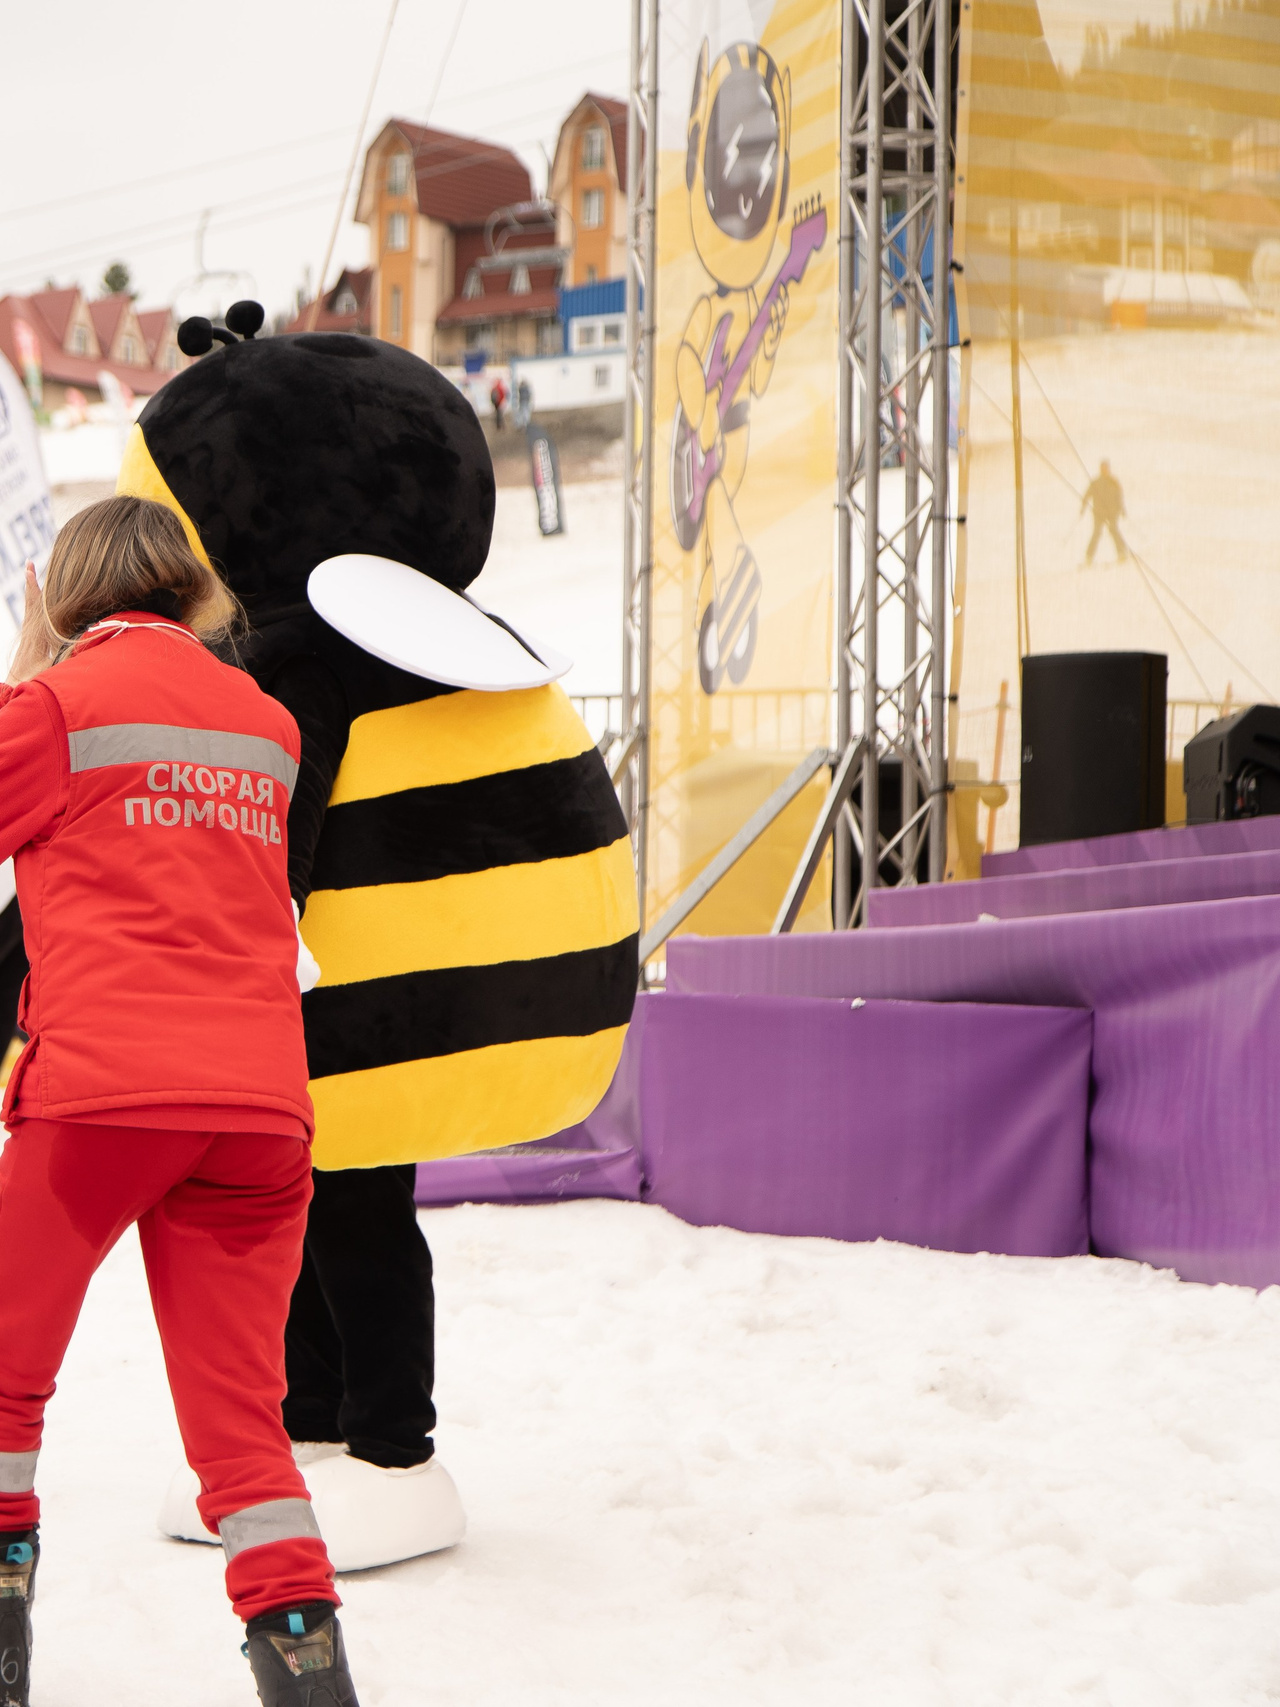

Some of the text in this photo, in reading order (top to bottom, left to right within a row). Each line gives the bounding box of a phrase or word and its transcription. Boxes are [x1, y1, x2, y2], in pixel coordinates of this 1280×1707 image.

[146, 763, 274, 808] СКОРАЯ
[124, 797, 282, 846] ПОМОЩЬ
[0, 1646, 20, 1685] 6
[302, 1658, 323, 1671] 23.5
